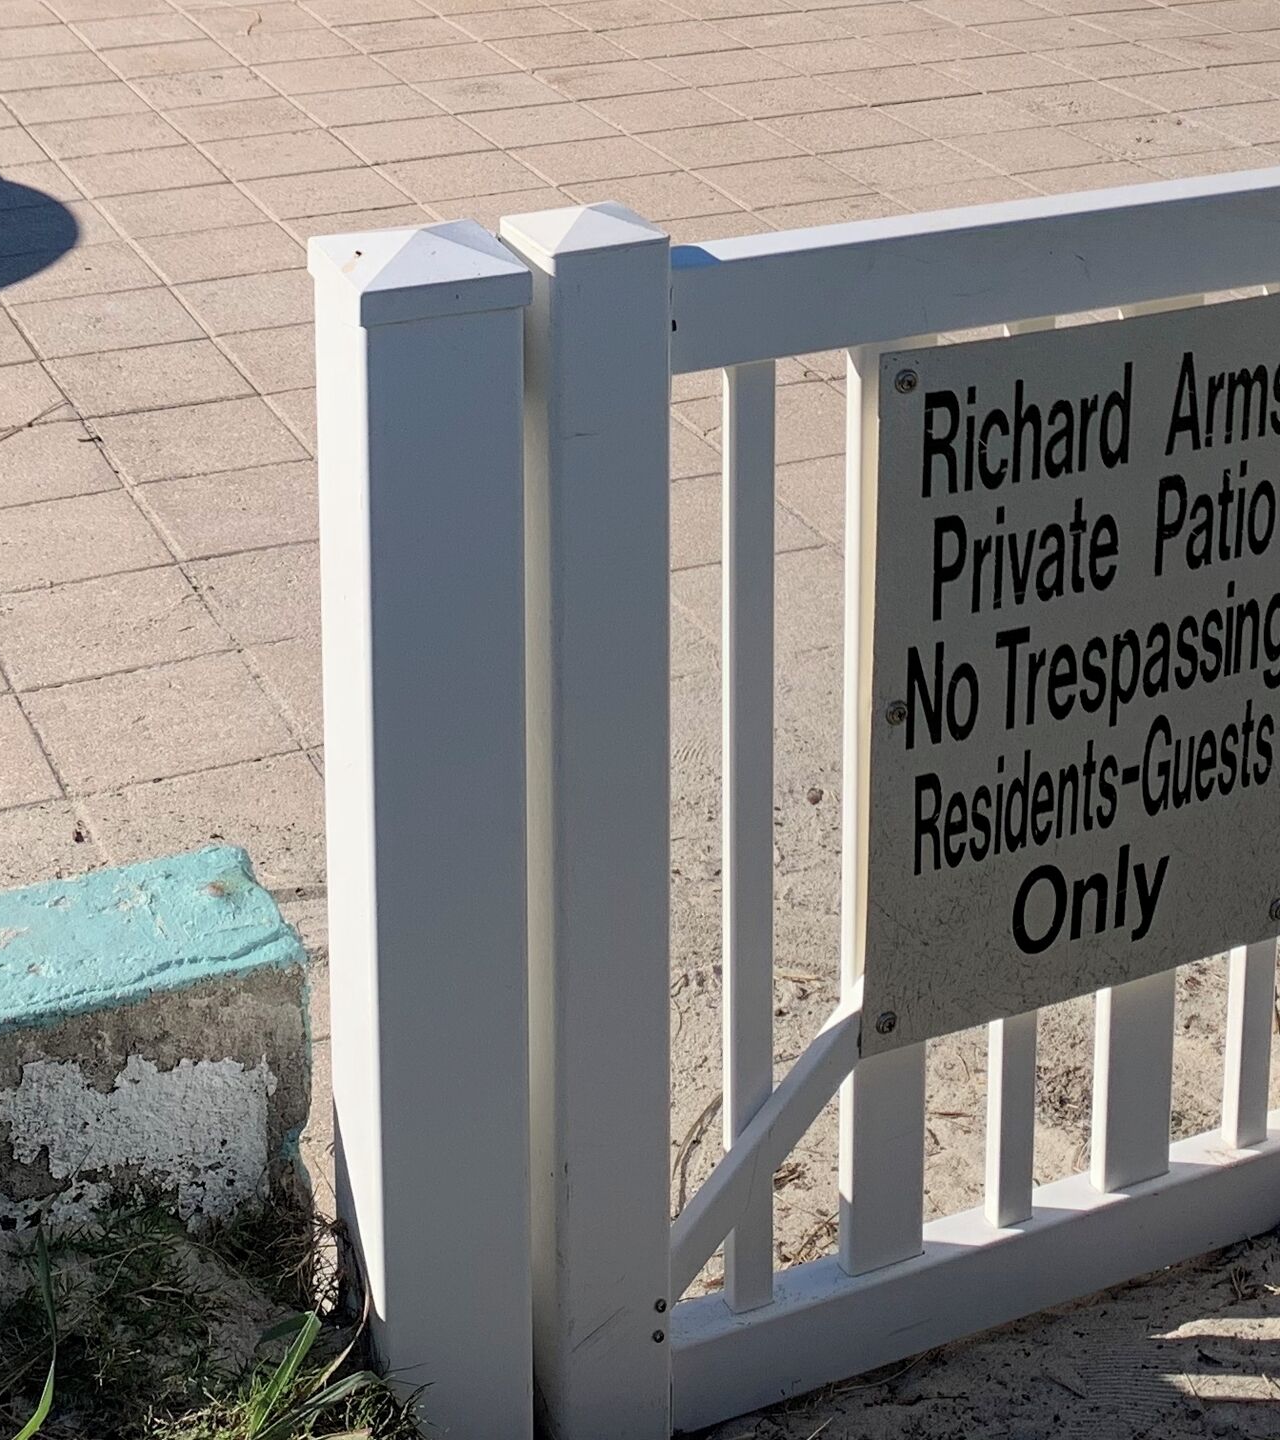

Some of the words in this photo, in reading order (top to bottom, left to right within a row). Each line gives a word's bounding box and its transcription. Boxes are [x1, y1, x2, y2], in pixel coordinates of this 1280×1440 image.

[921, 361, 1133, 498] Richard
[932, 497, 1119, 621] Private
[1154, 460, 1276, 577] Patio
[905, 640, 979, 750] No
[913, 699, 1275, 876] Residents-Guests
[1011, 843, 1170, 955] Only
